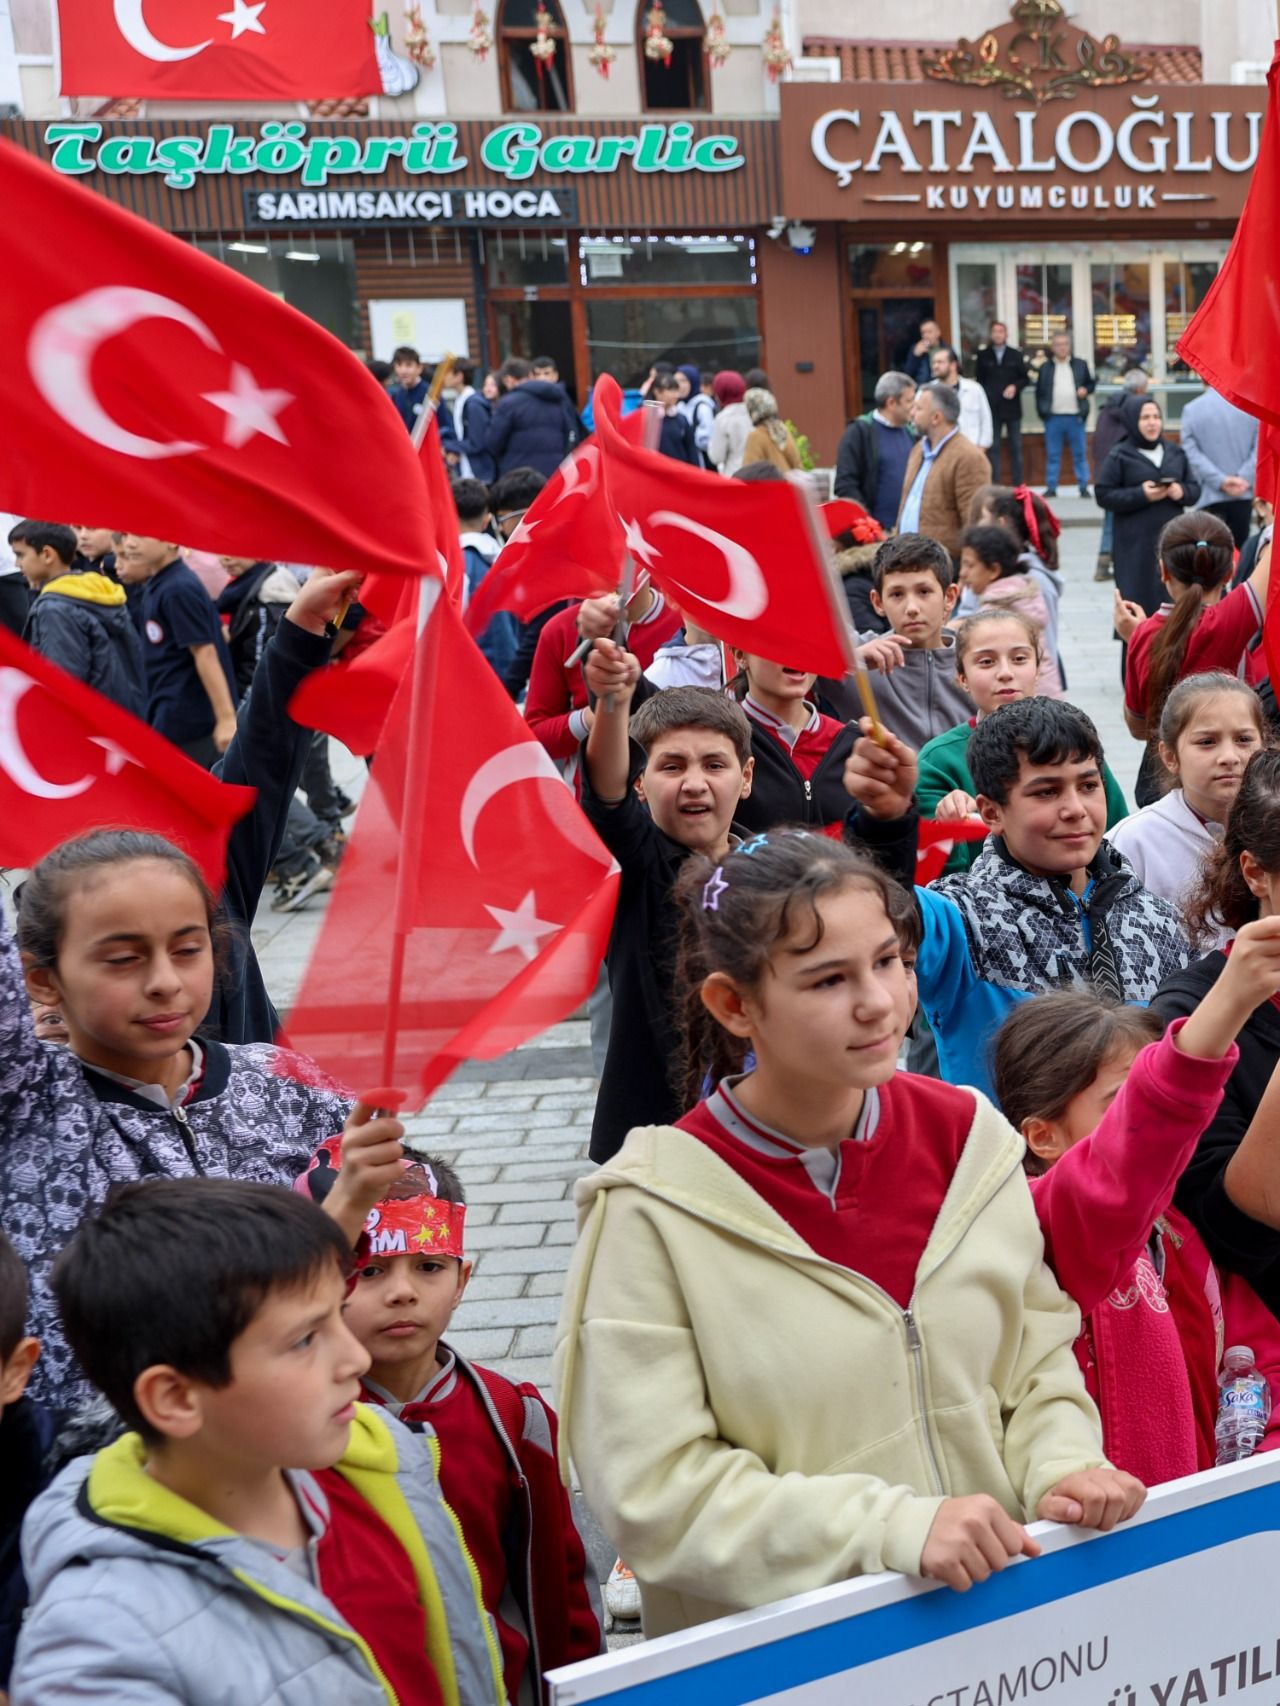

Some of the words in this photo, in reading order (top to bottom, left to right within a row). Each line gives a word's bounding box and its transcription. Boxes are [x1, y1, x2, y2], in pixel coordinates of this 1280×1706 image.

[44, 122, 468, 189] Taşköprü
[480, 121, 746, 180] Garlic
[810, 95, 1263, 188] ÇATALOĞLU
[258, 191, 453, 223] SARIMSAKÇI
[464, 190, 561, 218] HOCA
[926, 185, 1156, 209] KUYUMCULUK
